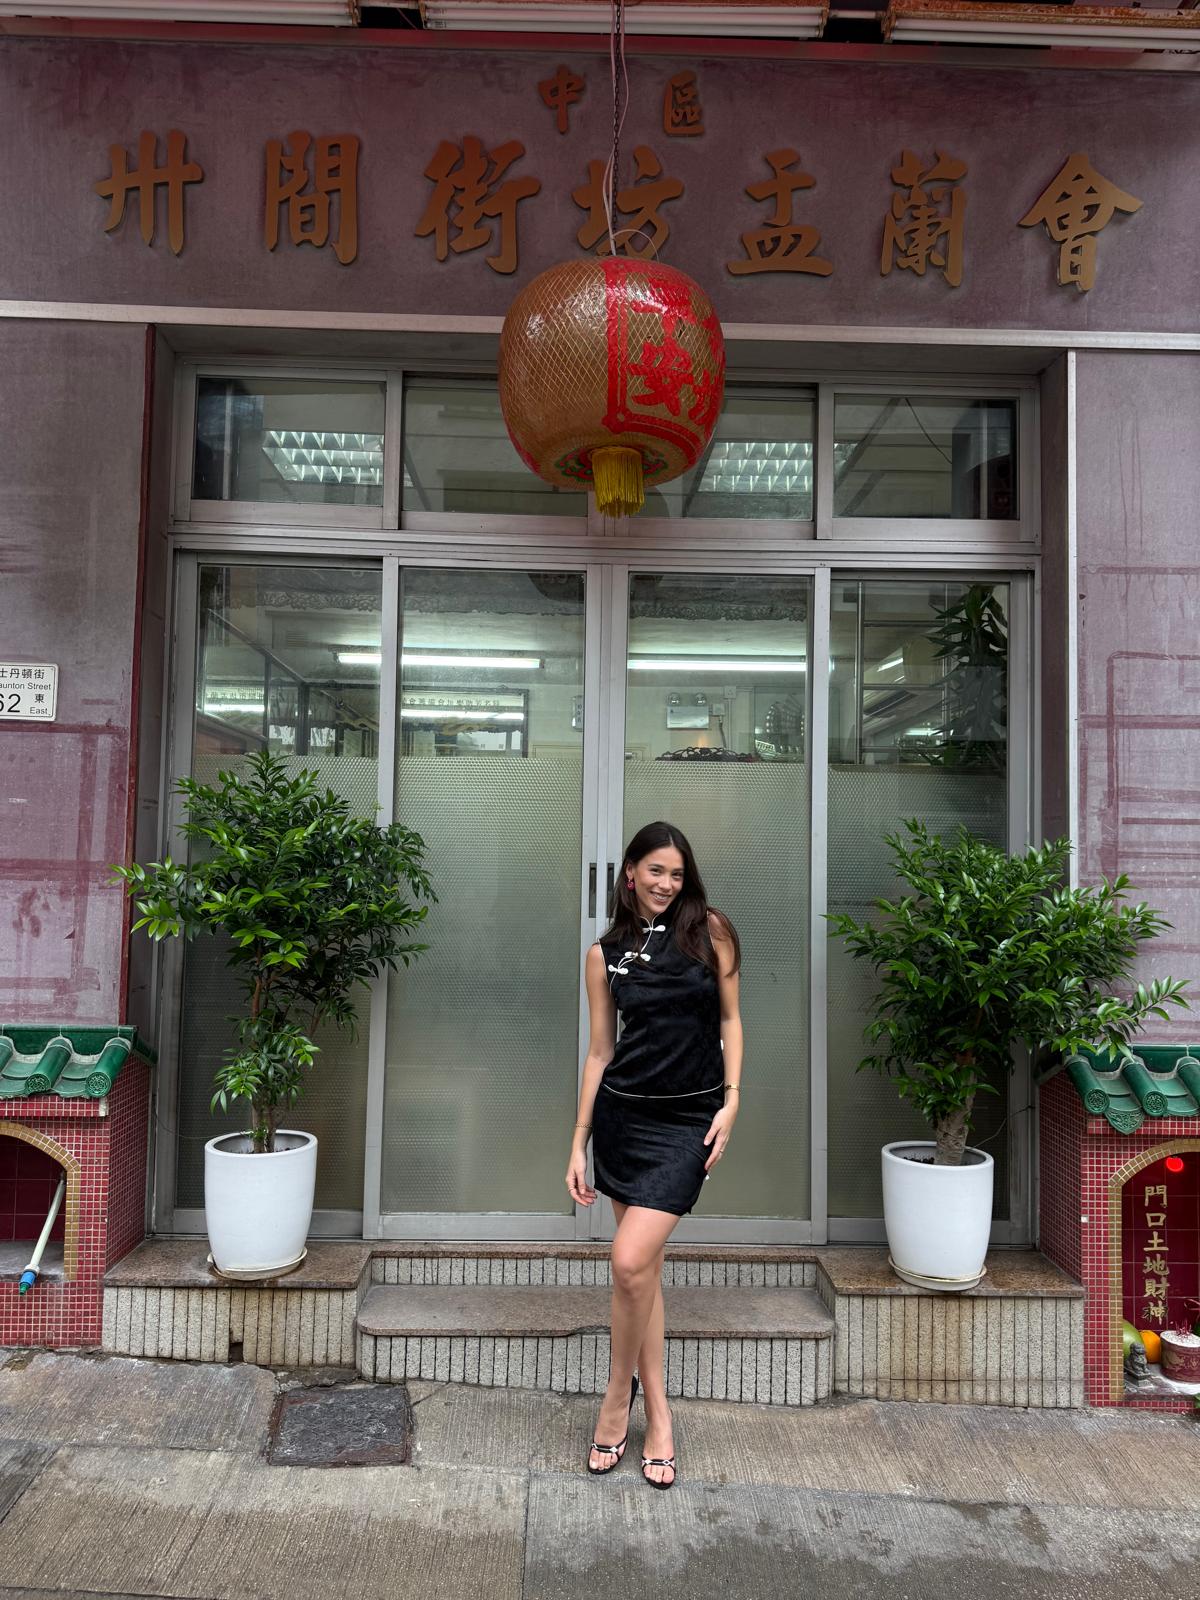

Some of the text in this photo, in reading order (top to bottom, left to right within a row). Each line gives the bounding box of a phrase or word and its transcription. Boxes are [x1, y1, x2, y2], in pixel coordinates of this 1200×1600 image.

[539, 65, 704, 136] 中區
[0, 668, 45, 679] 士丹頓街
[27, 682, 51, 690] Street
[34, 693, 45, 703] 東
[29, 706, 48, 715] East
[1142, 1184, 1170, 1325] 門口土地財神
